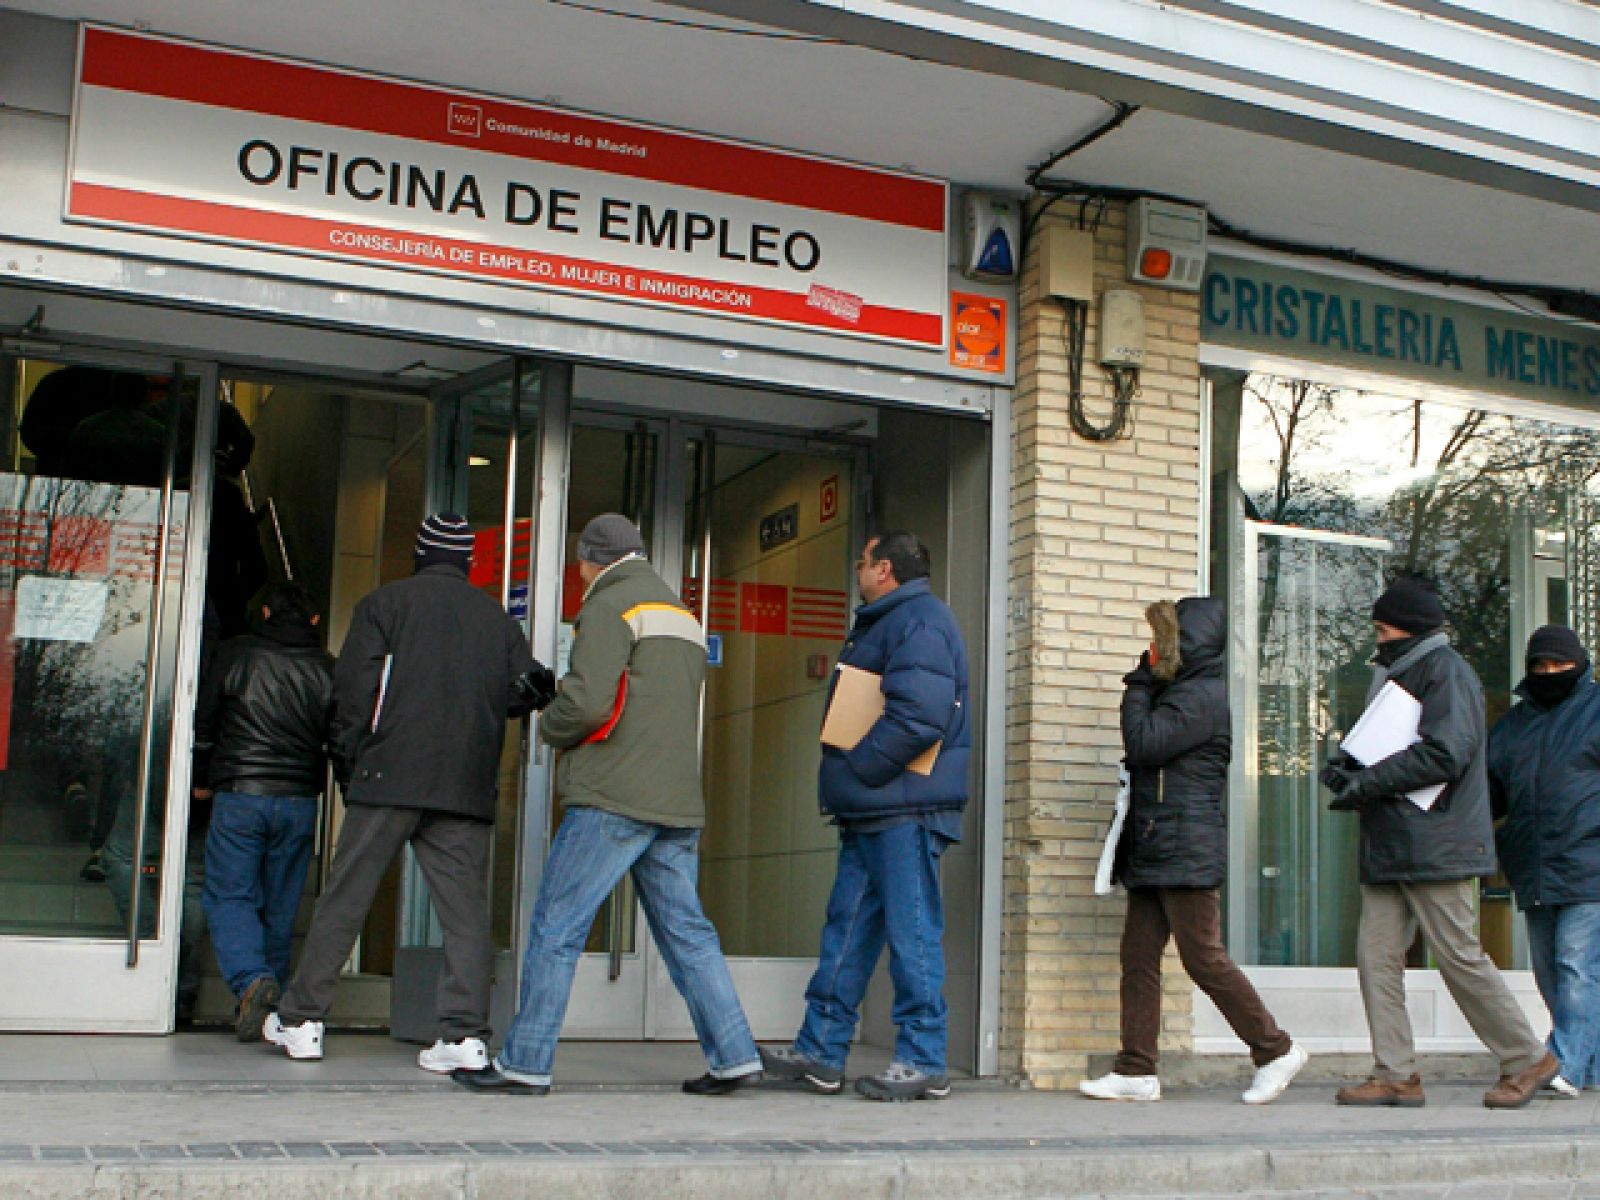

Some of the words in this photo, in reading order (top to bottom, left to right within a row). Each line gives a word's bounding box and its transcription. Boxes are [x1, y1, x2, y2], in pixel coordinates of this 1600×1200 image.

[485, 117, 571, 143] Comunidad
[575, 134, 593, 148] de
[597, 137, 647, 158] Madrid
[237, 139, 486, 219] OFICINA
[504, 181, 581, 233] DE
[599, 197, 821, 272] EMPLEO
[328, 229, 446, 261] CONSEJERÍA
[449, 246, 474, 263] DE
[479, 251, 556, 278] EMPLEO,
[560, 264, 621, 287] MUJER
[624, 274, 636, 291] E
[639, 276, 751, 307] INMIGRACIÓN
[1206, 272, 1463, 371] CRISTALERIA
